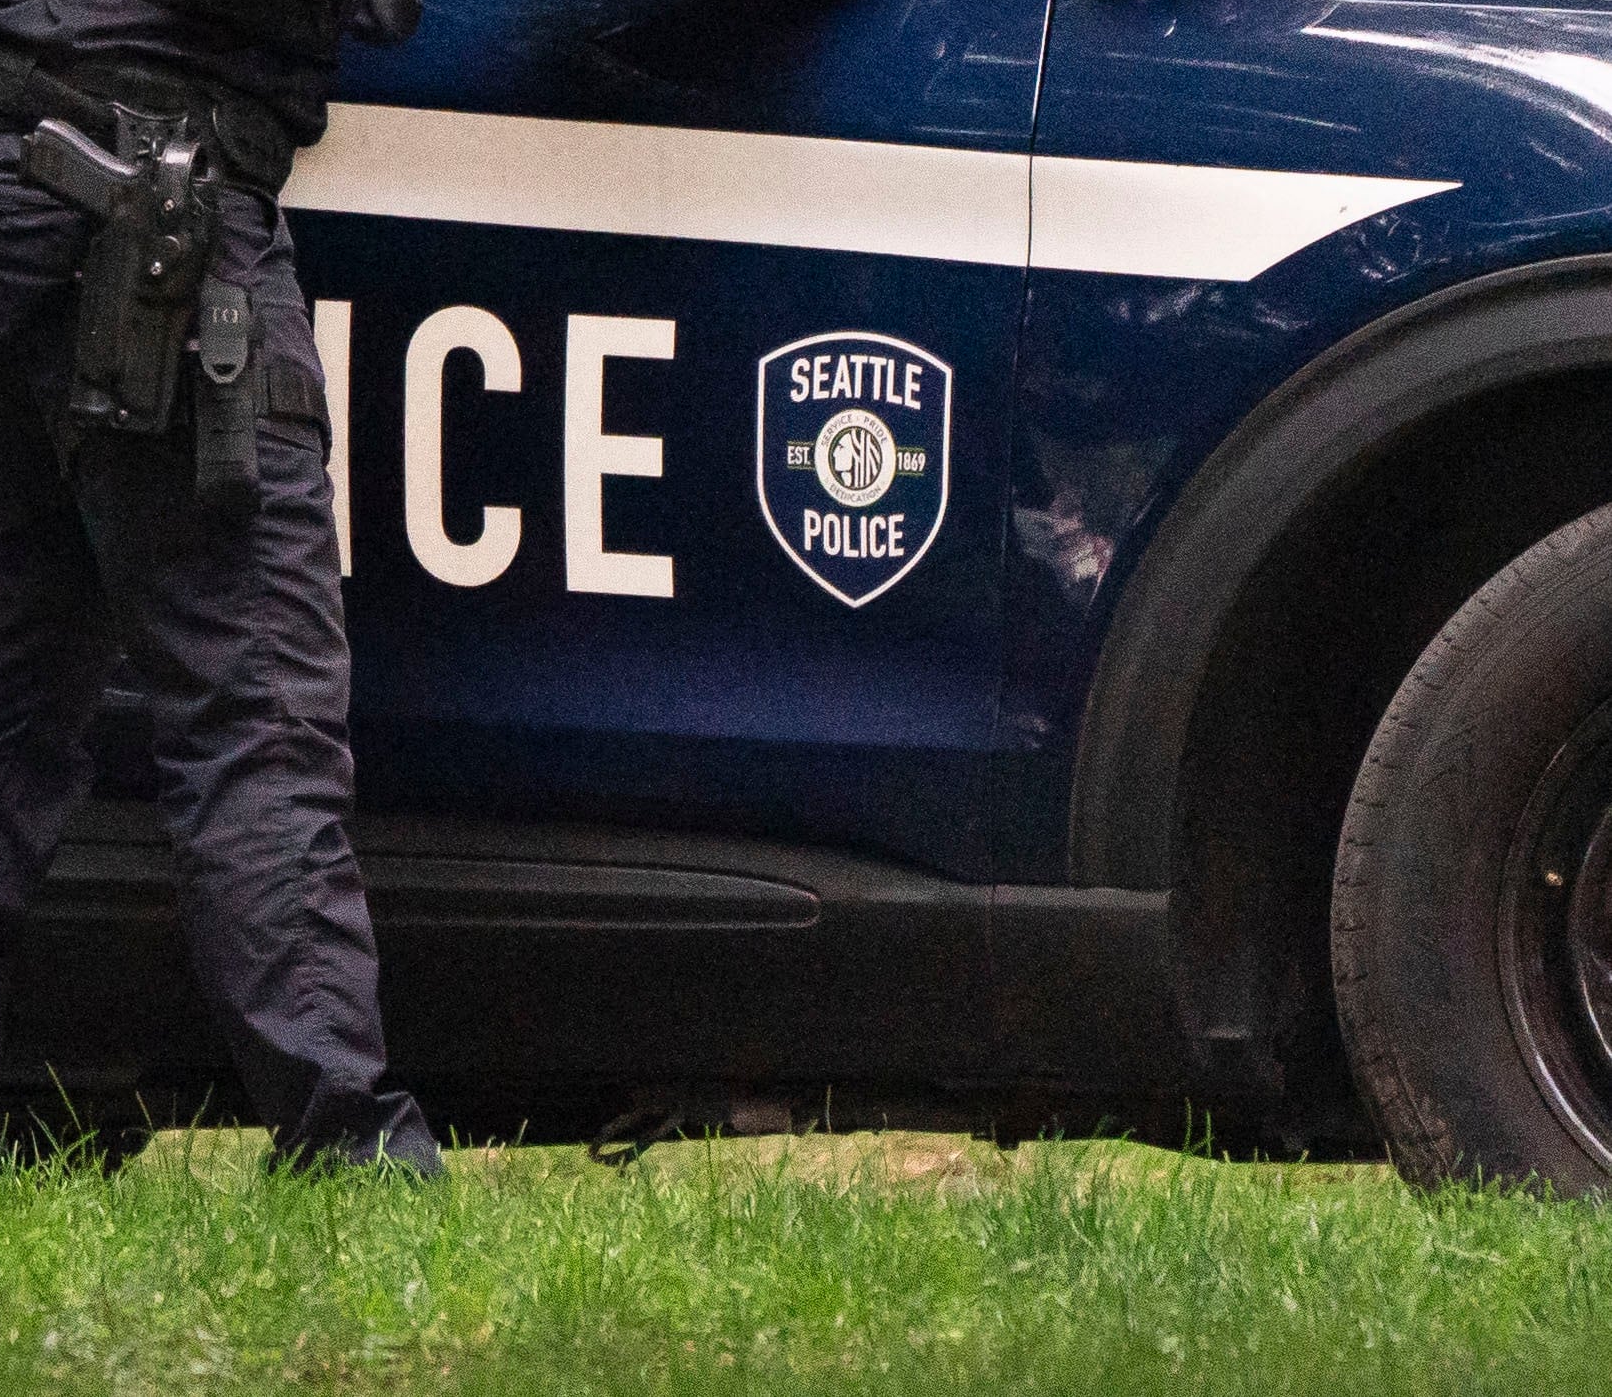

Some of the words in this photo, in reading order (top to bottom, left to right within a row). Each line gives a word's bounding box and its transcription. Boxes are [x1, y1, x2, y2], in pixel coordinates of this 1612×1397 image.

[790, 354, 923, 411] SEATTLE
[864, 416, 888, 444] PRIDE
[787, 446, 812, 466] EST.
[897, 452, 926, 472] 1869
[804, 508, 905, 559] POLICE
